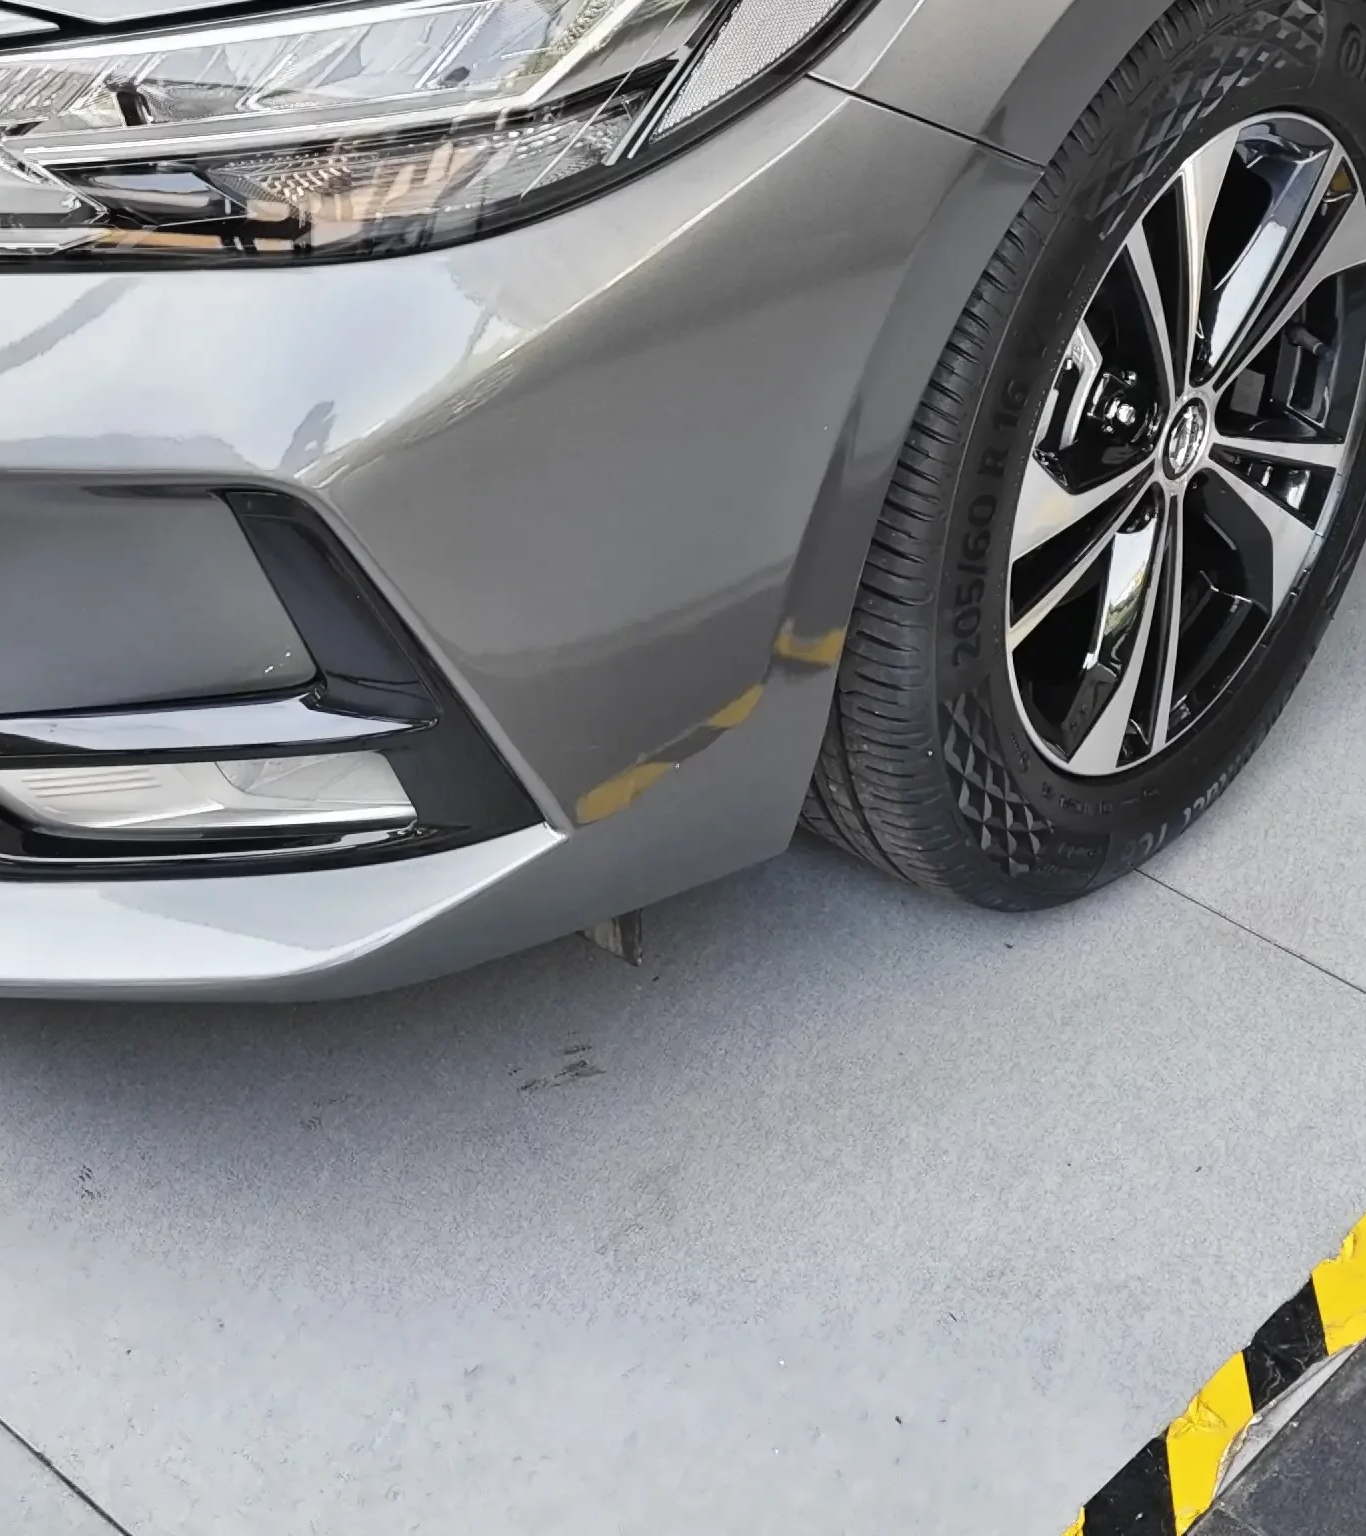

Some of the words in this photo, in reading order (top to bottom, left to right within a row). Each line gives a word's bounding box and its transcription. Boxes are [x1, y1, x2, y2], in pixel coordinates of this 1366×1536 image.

[952, 493, 998, 667] 205/60
[976, 450, 1007, 478] R
[993, 378, 1030, 431] 16
